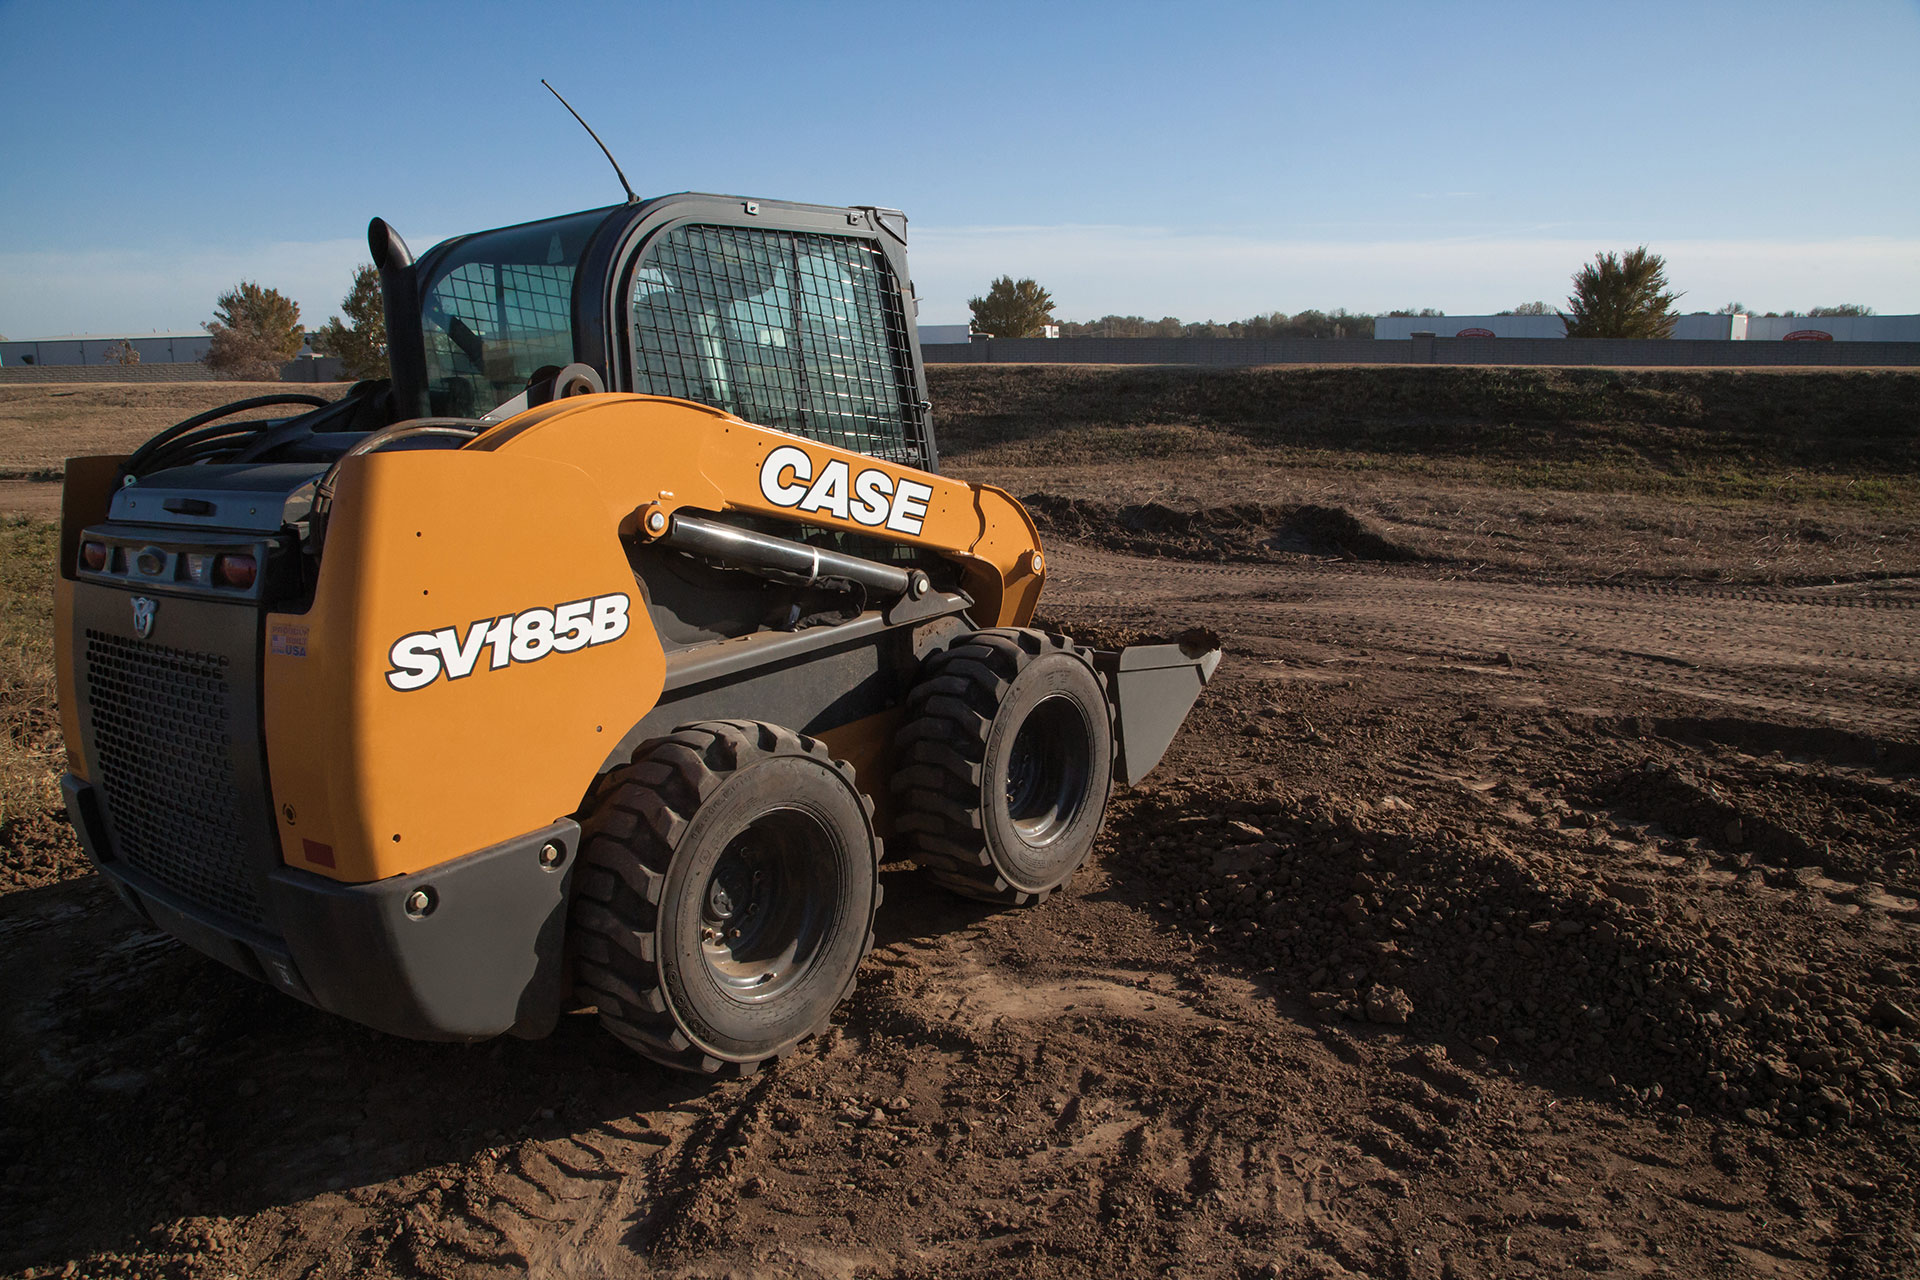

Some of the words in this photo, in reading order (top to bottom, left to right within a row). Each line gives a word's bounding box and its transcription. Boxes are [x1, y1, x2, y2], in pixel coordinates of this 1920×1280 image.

[760, 446, 934, 536] CASE
[286, 645, 306, 657] USA
[386, 593, 630, 691] SV185B
